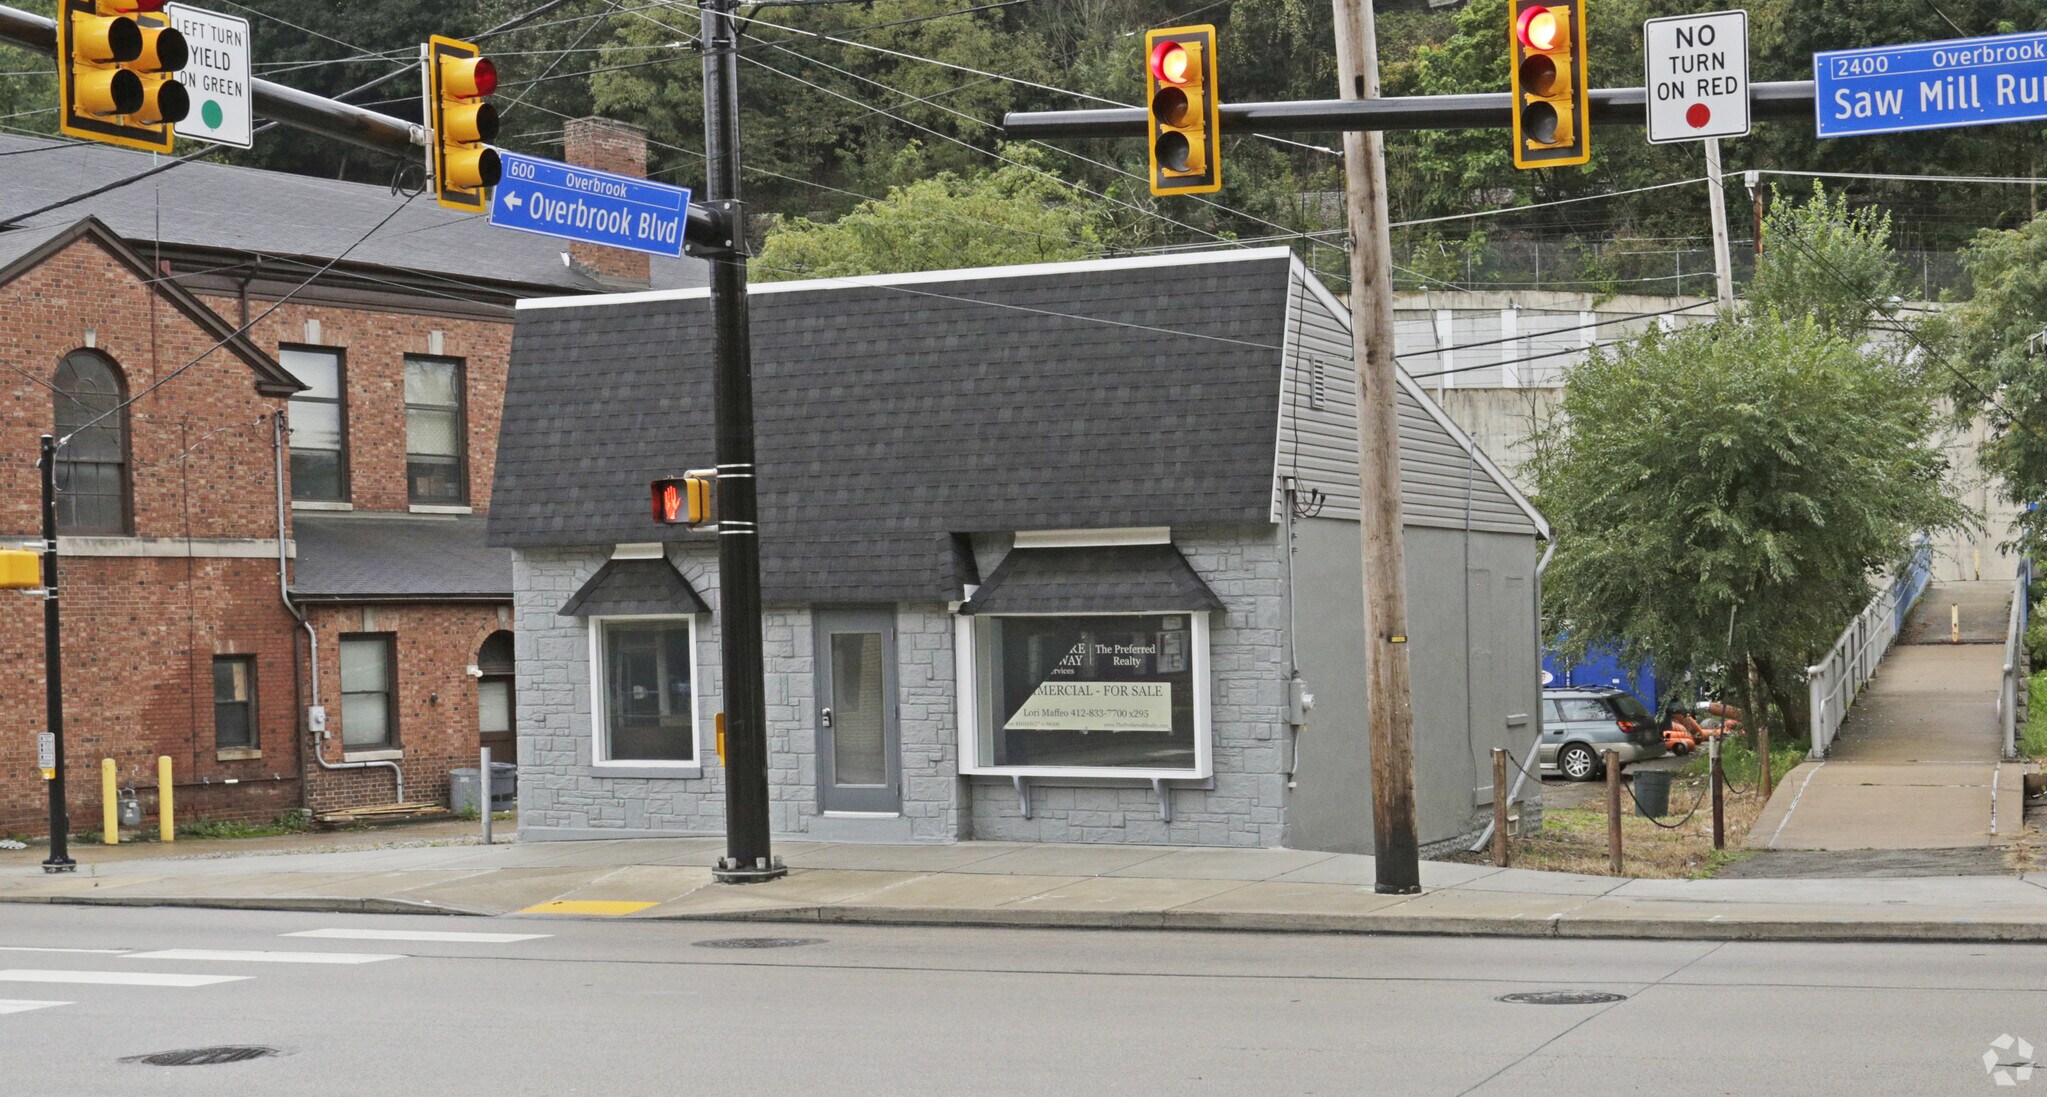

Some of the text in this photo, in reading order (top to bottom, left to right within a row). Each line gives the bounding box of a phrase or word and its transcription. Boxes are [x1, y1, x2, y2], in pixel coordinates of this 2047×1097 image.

[176, 18, 242, 47] LEFT TURN
[1676, 24, 1716, 49] NO
[190, 45, 231, 71] YIELD
[1669, 51, 1725, 74] TURN
[1837, 41, 2045, 77] 2400 Overbrook
[180, 70, 242, 97] ON GREEN
[1657, 76, 1738, 101] ON RED
[1834, 88, 1903, 120] Saw
[1919, 74, 1981, 113] Mill
[511, 161, 627, 198] 600 Overbrook
[529, 191, 679, 244] Overbrook Blvd
[1095, 644, 1112, 654] The
[1114, 644, 1156, 654] Preferred
[1113, 655, 1142, 668] Realty
[1033, 685, 1094, 696] MERCIAL
[1103, 685, 1129, 697] FOR
[1131, 685, 1163, 697] SALE
[1023, 708, 1149, 718] Lori Maffeo 412-833-7700 x295
